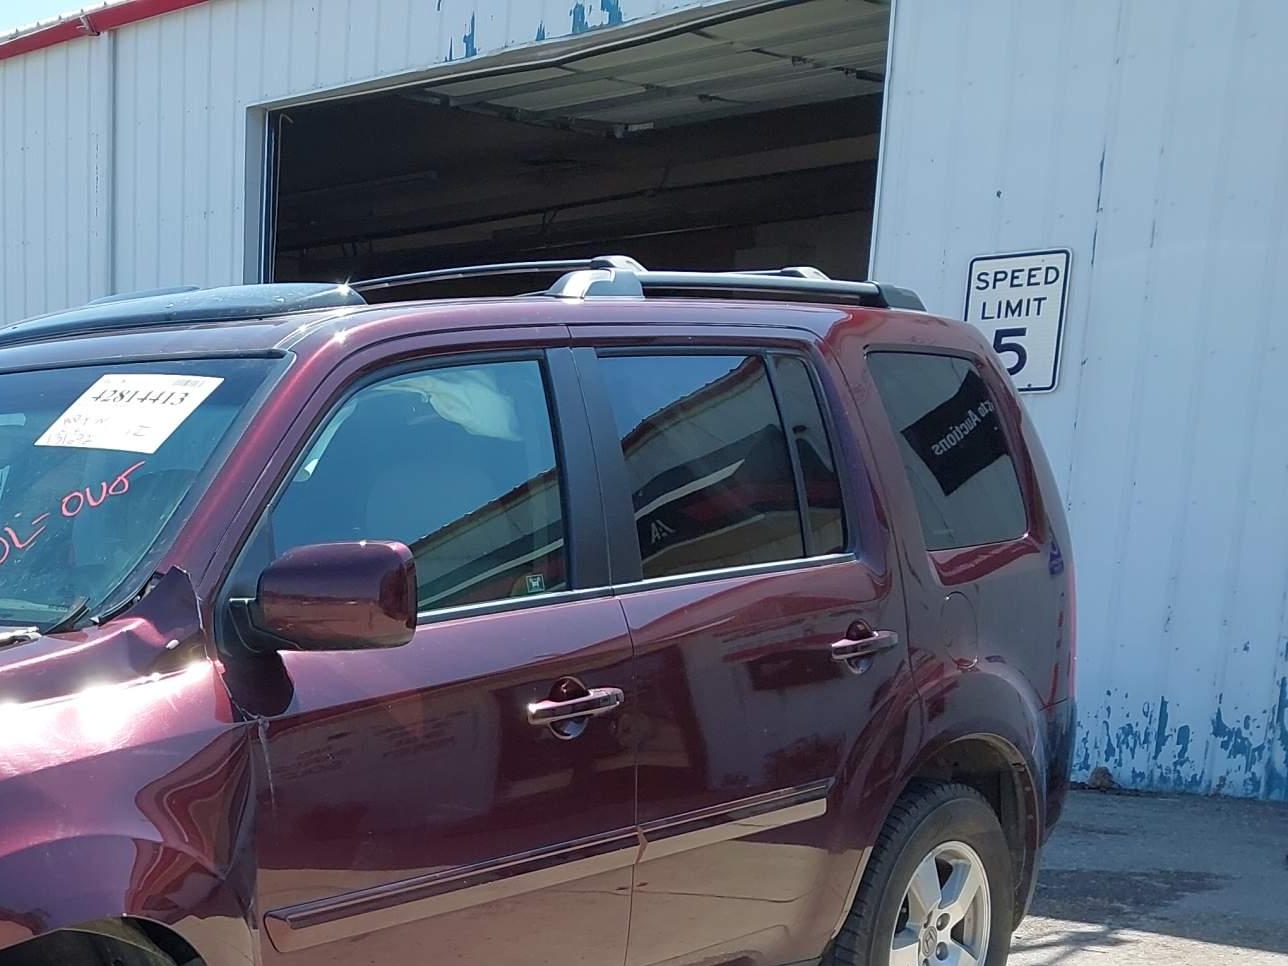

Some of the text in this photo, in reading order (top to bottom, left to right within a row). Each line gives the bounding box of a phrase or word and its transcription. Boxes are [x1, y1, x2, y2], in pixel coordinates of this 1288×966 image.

[975, 266, 1060, 291] SPEED
[981, 296, 1047, 320] LIMIT
[993, 327, 1027, 376] 5
[91, 389, 189, 406] 42814413
